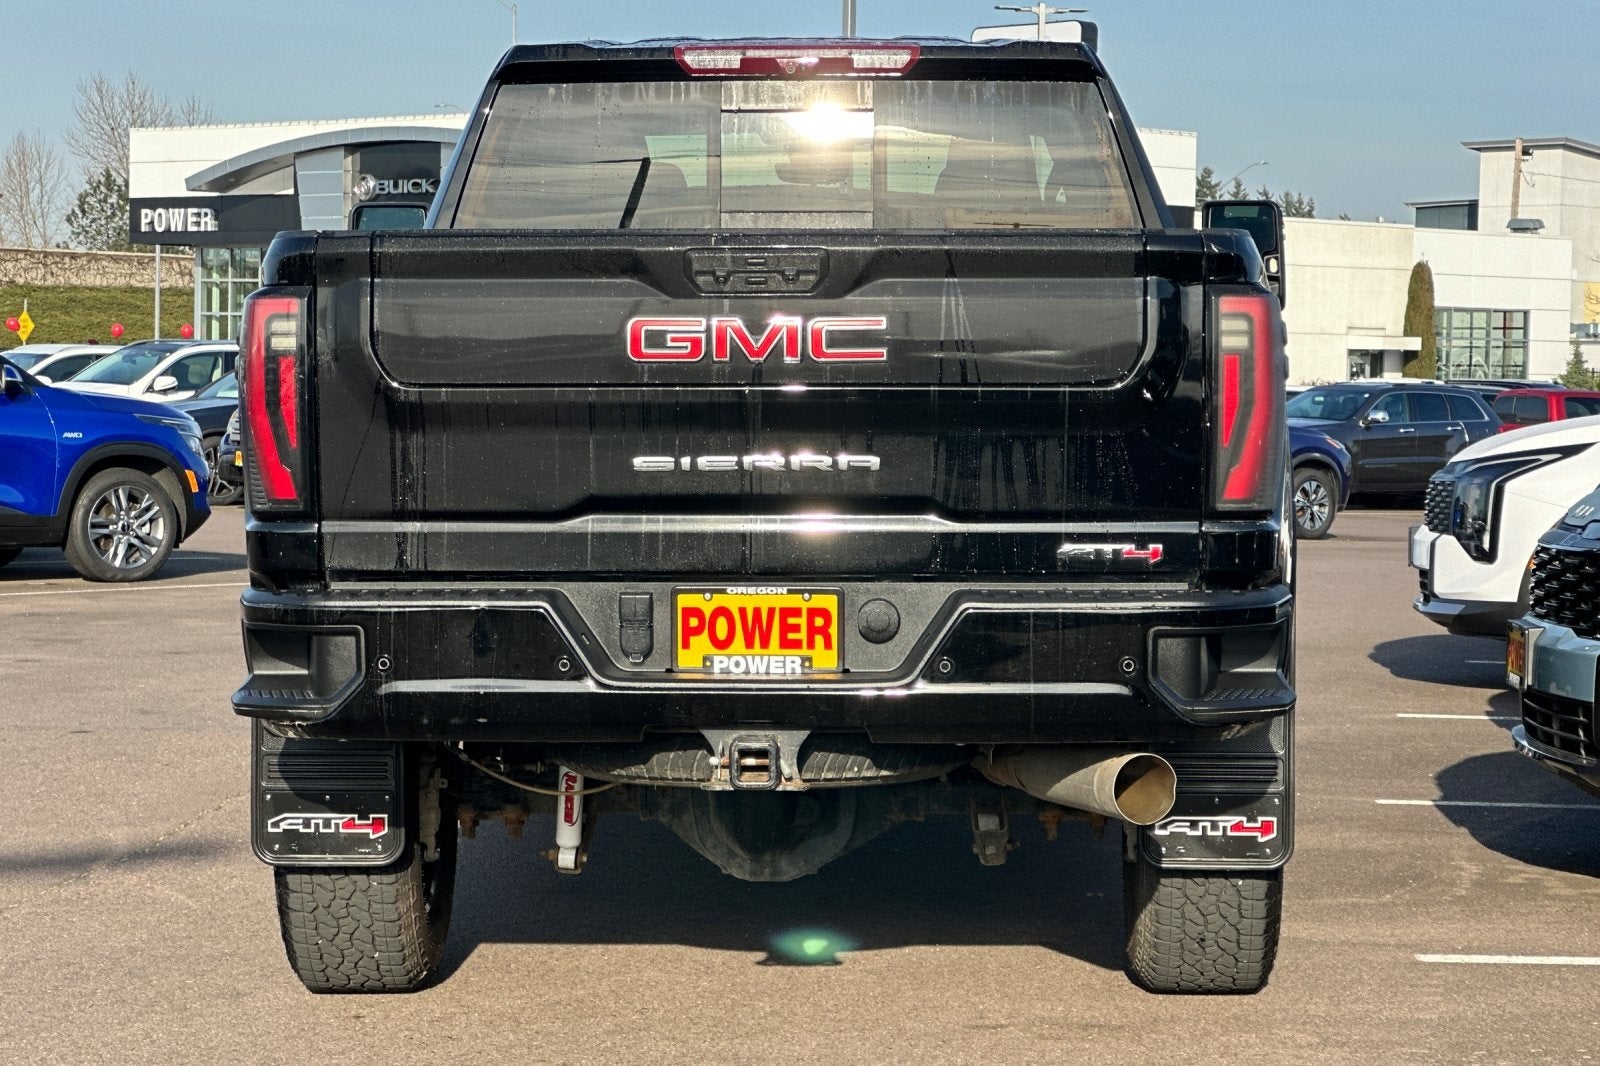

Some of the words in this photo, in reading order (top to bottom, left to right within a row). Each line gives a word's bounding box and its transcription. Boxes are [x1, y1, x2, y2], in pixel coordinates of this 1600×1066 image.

[375, 178, 436, 194] BUICK
[140, 207, 215, 232] POWER
[626, 316, 888, 363] GMC
[632, 453, 881, 472] SIERRA
[1057, 543, 1163, 564] AT4
[726, 587, 788, 595] OREGON
[681, 606, 834, 651] POWER
[713, 655, 802, 674] POWER
[267, 812, 389, 839] AT4
[1154, 816, 1277, 842] AT4
